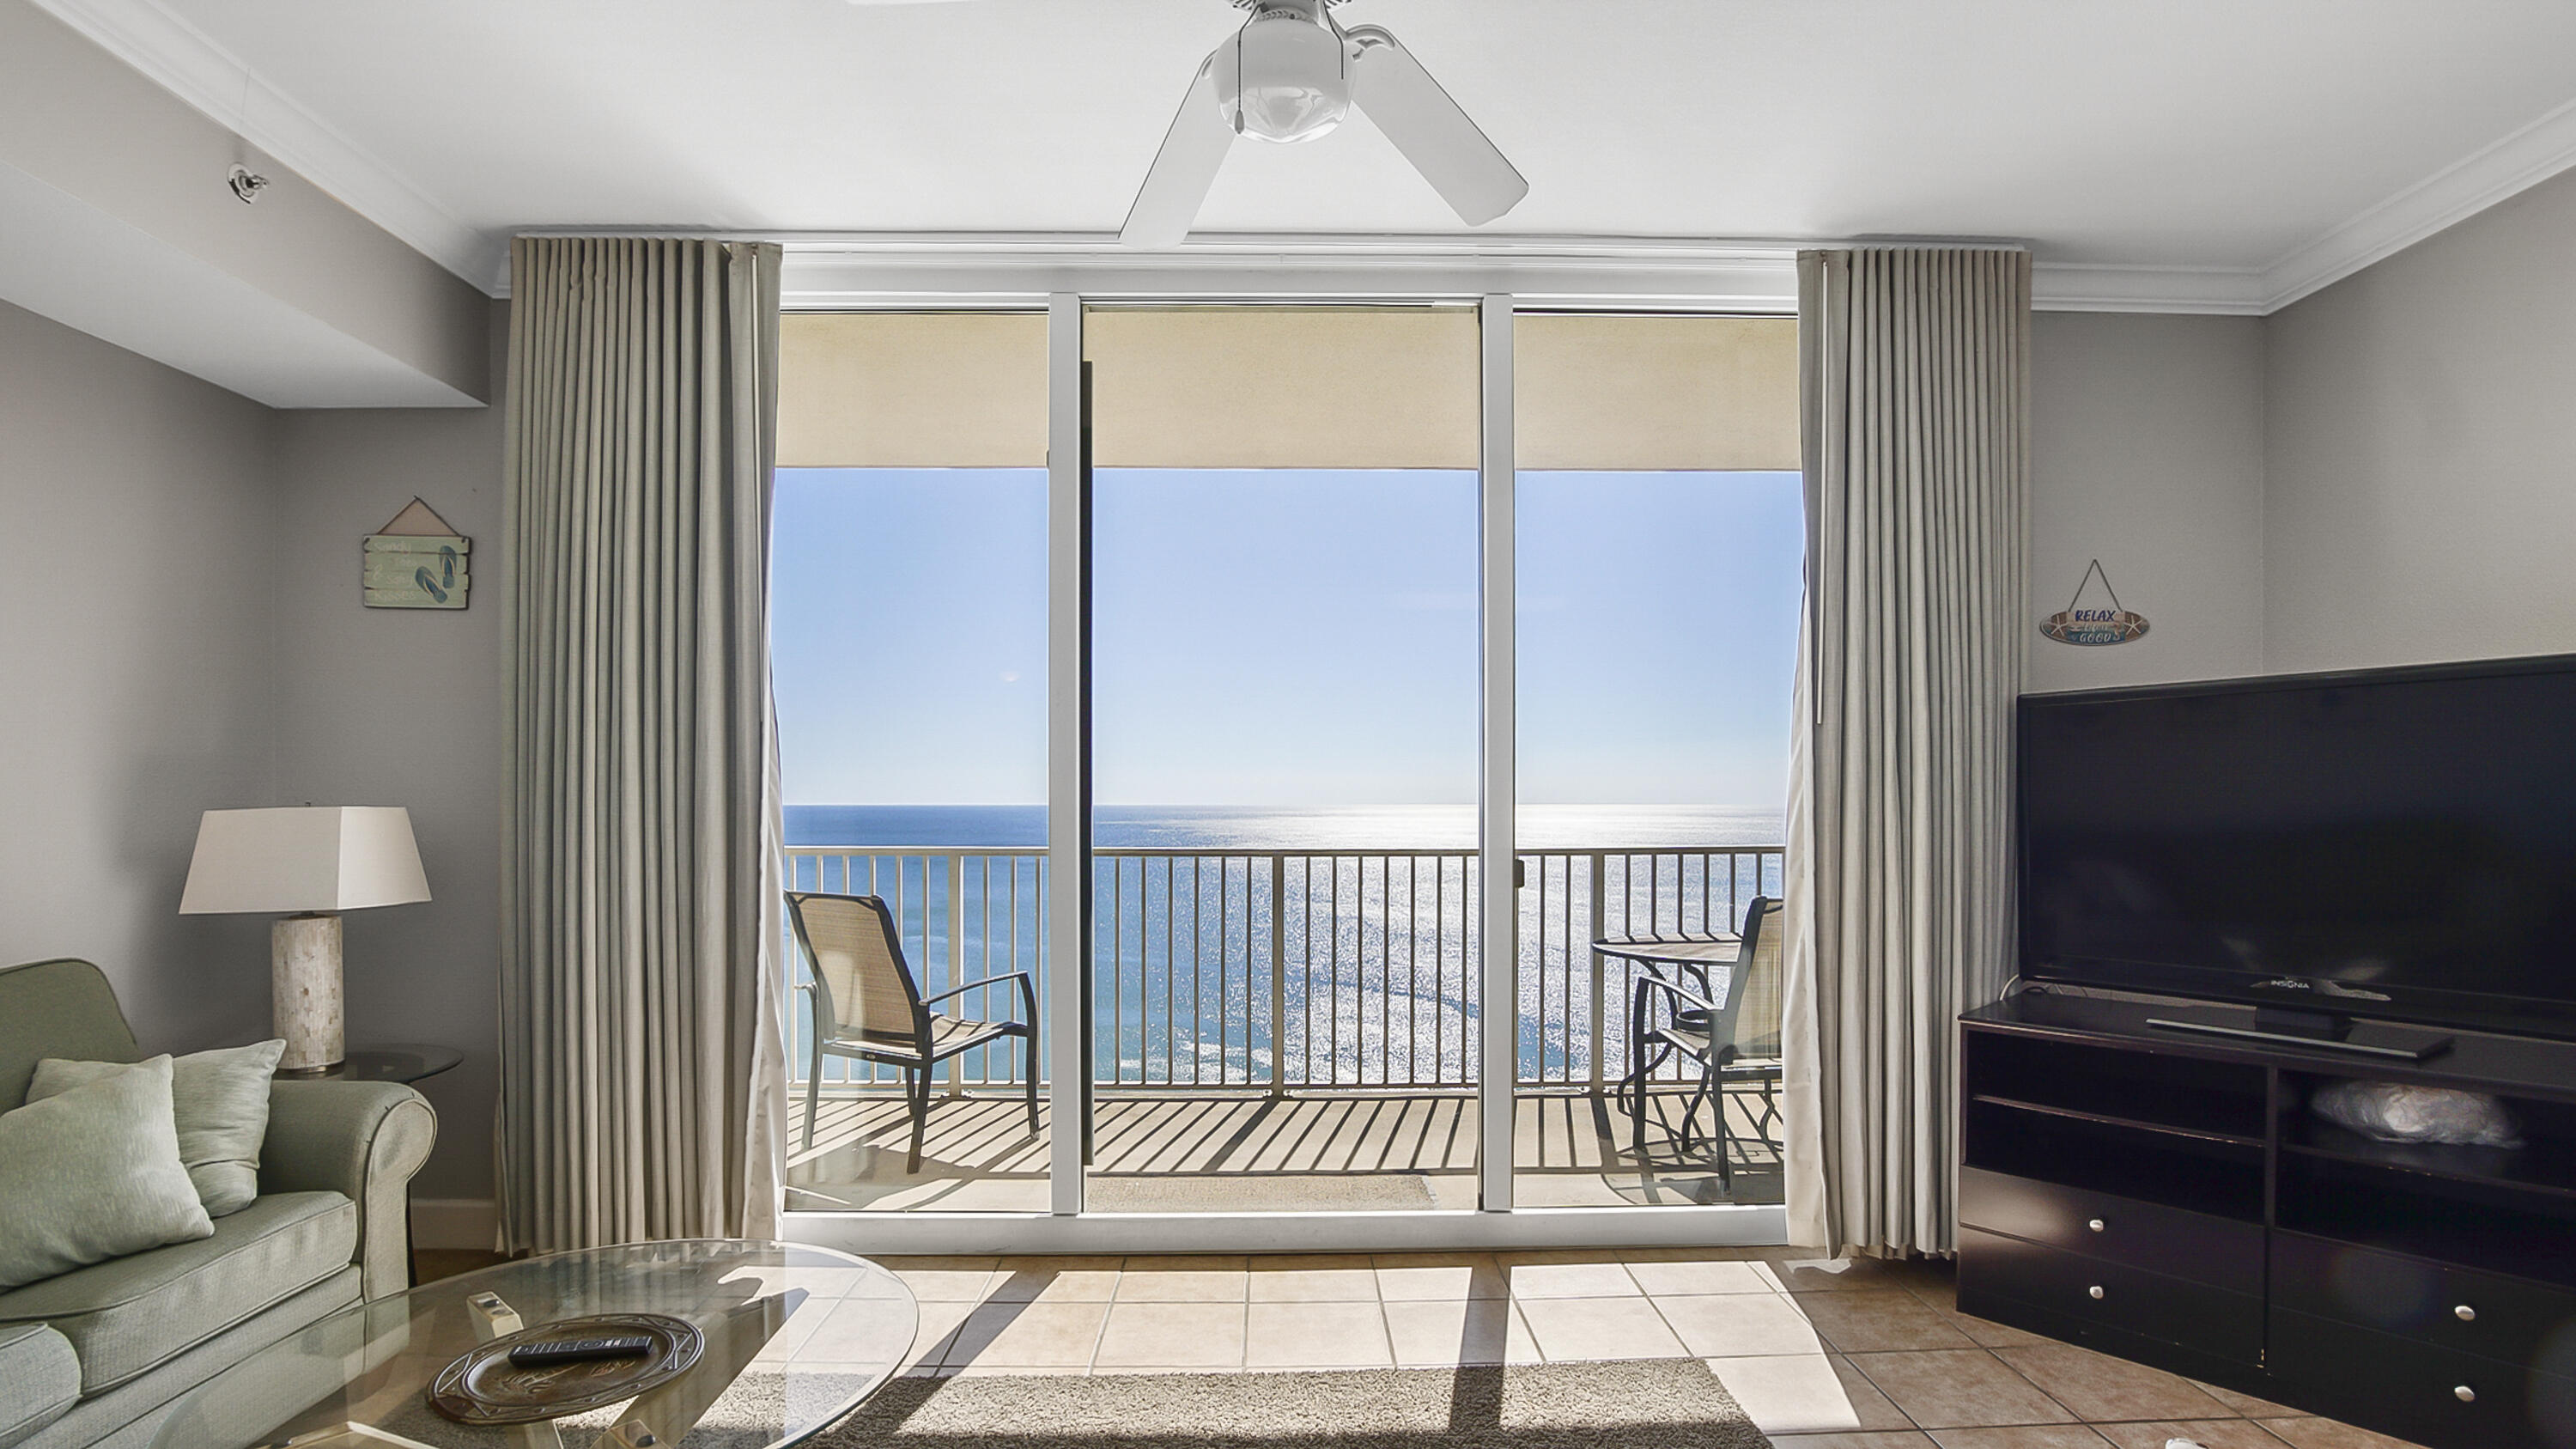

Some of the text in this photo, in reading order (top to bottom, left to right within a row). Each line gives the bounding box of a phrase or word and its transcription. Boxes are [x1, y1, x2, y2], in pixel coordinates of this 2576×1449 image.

[2075, 610, 2117, 622] RELAX
[2080, 632, 2111, 642] GOOD
[2270, 978, 2310, 989] INSIGNIA
